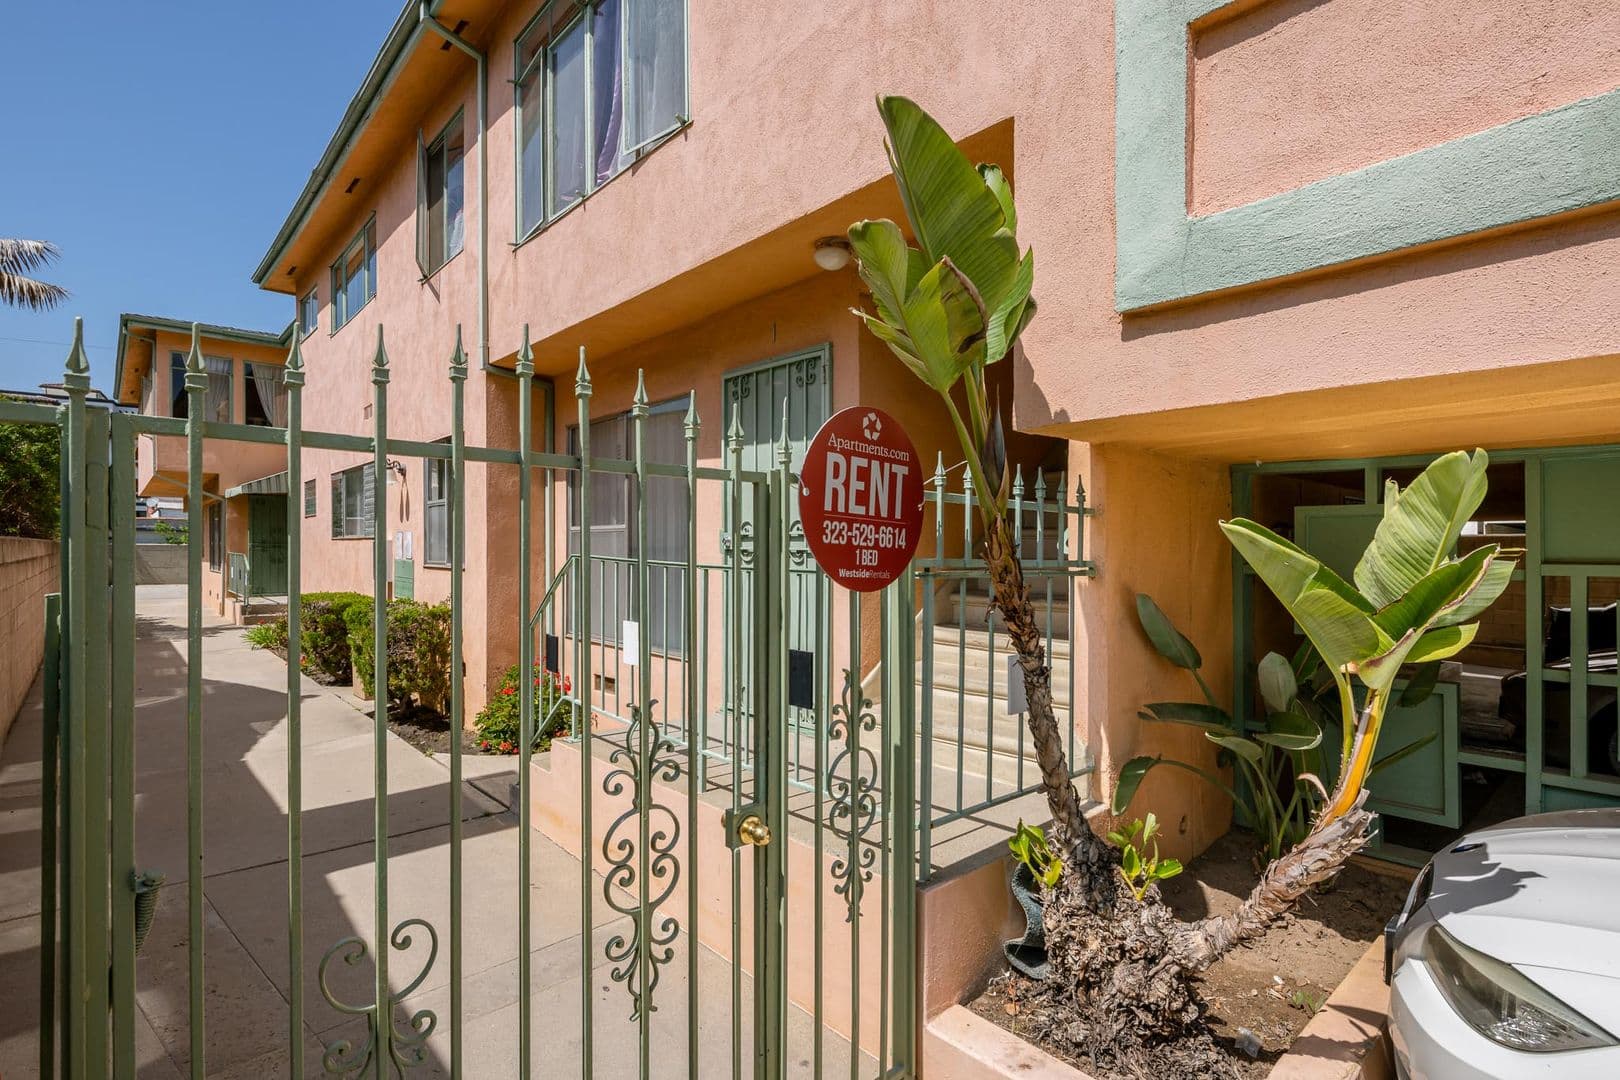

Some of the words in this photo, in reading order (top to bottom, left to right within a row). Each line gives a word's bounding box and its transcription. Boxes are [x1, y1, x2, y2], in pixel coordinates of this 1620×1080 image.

[828, 432, 910, 462] Apartments.com
[824, 451, 909, 520] RENT
[822, 520, 907, 549] 323-529-6614
[855, 549, 860, 565] 1
[861, 549, 878, 566] BED
